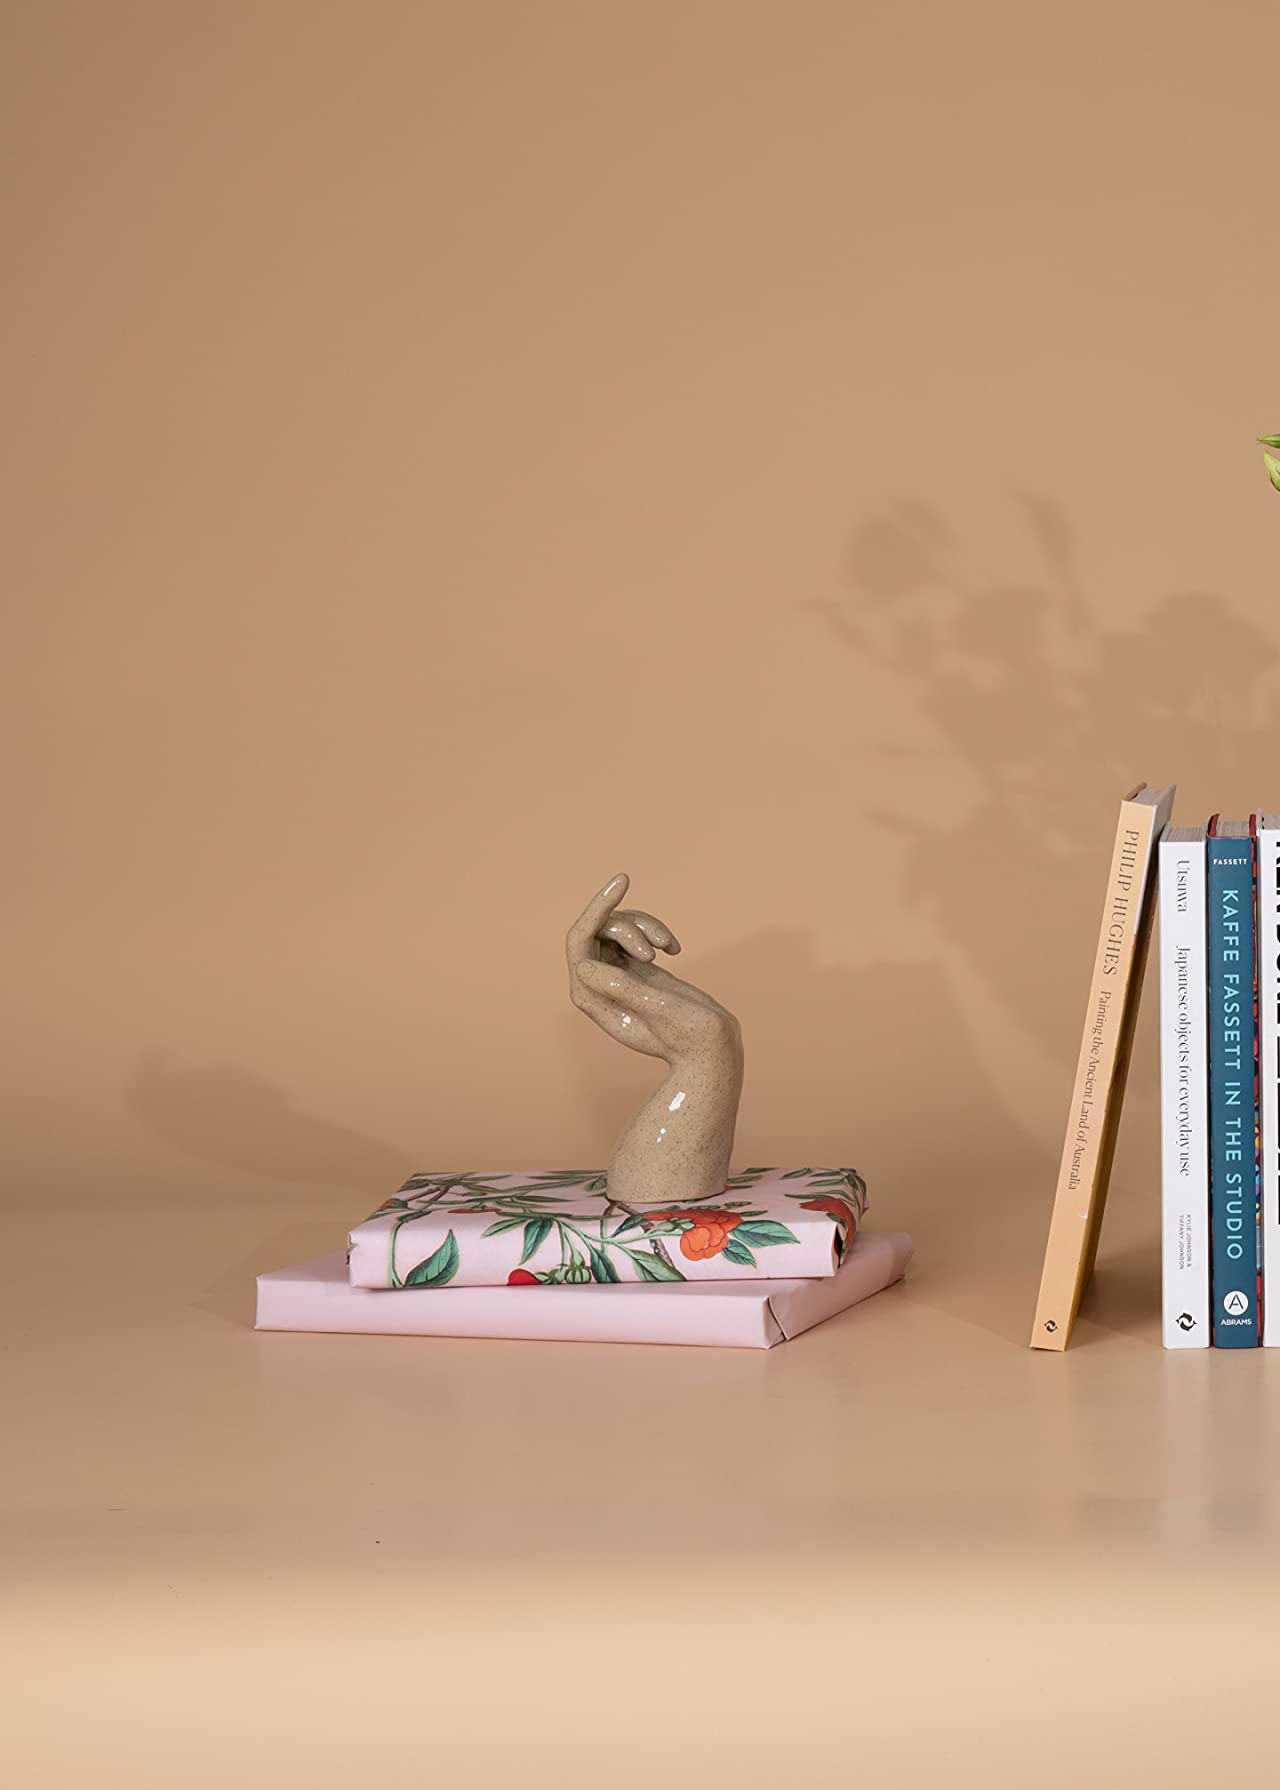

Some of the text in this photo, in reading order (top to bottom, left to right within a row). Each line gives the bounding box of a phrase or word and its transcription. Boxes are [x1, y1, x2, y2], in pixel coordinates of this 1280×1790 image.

[1102, 829, 1140, 976] PHILIP HUGHES
[1176, 860, 1191, 913] Utsuwa
[1068, 990, 1112, 1190] Painting the Ancient Land of Australia
[1174, 945, 1193, 1177] Japanese objects for everyday use
[1222, 889, 1243, 1259] KAFFE FASSETT IN THE STUDIO
[1220, 1318, 1253, 1326] ABRAMS
